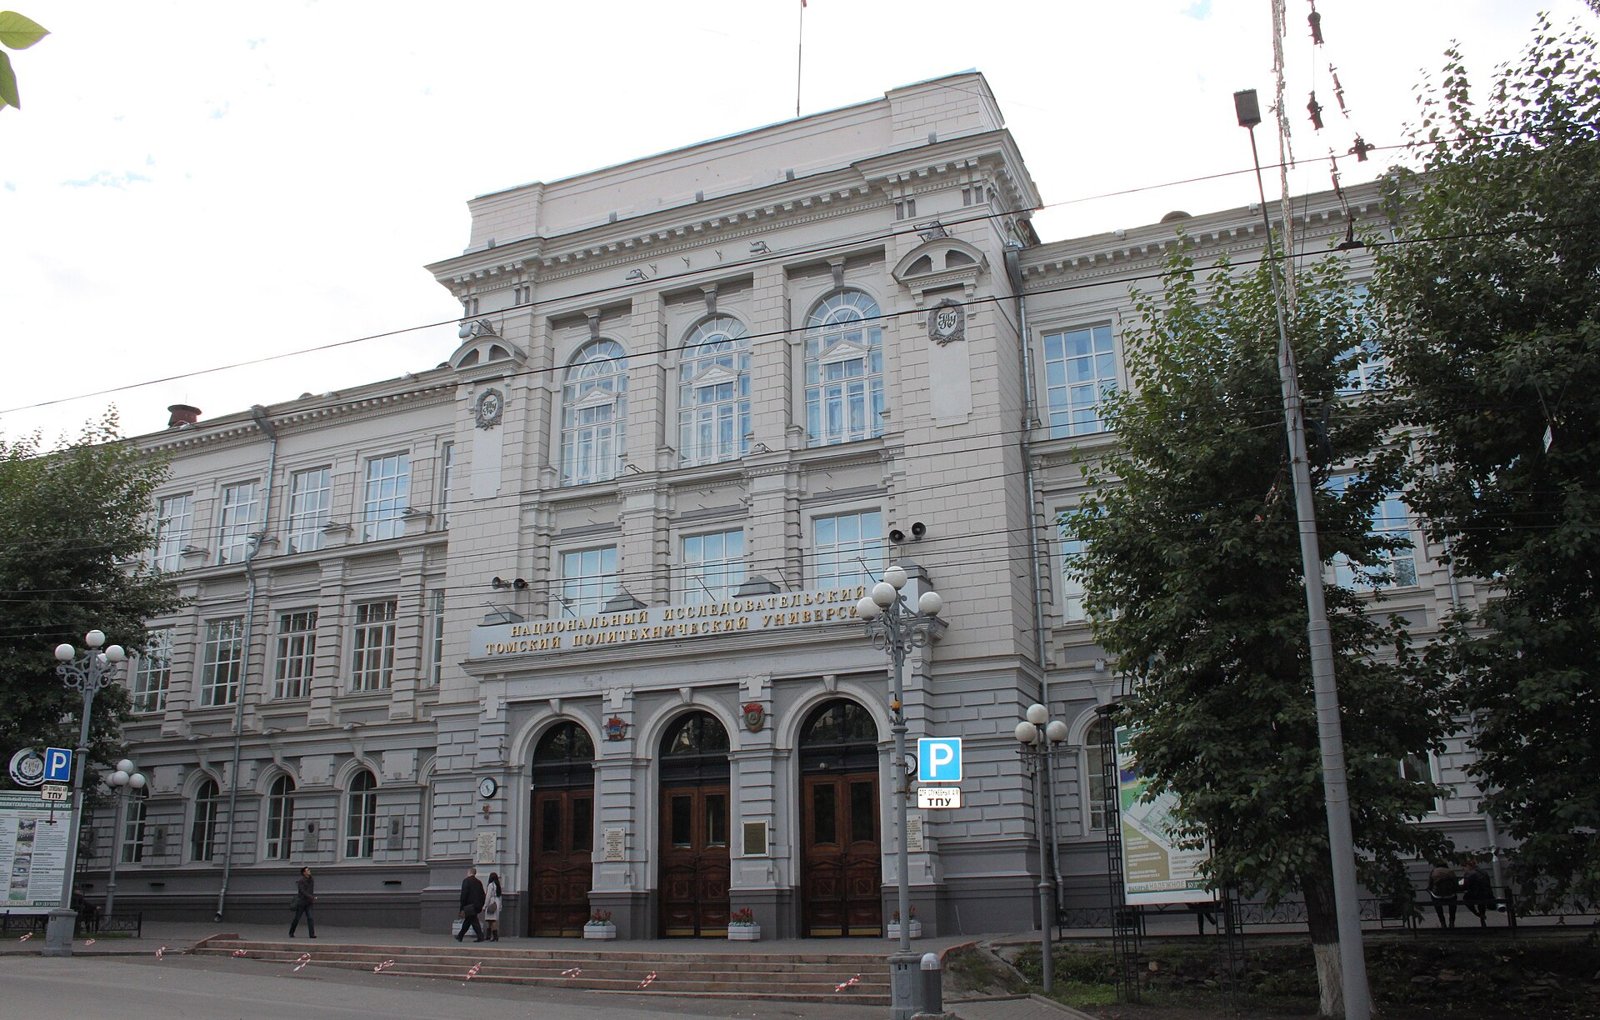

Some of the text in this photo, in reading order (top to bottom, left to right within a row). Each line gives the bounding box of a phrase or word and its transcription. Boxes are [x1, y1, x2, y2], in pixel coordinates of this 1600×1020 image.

[511, 586, 866, 638] НАЦИОНАЛЬНЫЙ ИССЛЕДОВАТЕЛЬСКИЙ
[486, 605, 860, 655] ТОМСКИЙ ПОЛИТЕХНИЧЕСКИЙ УНИВЕРСИ
[52, 753, 66, 777] P
[930, 743, 953, 777] P
[927, 798, 951, 806] ТПУ
